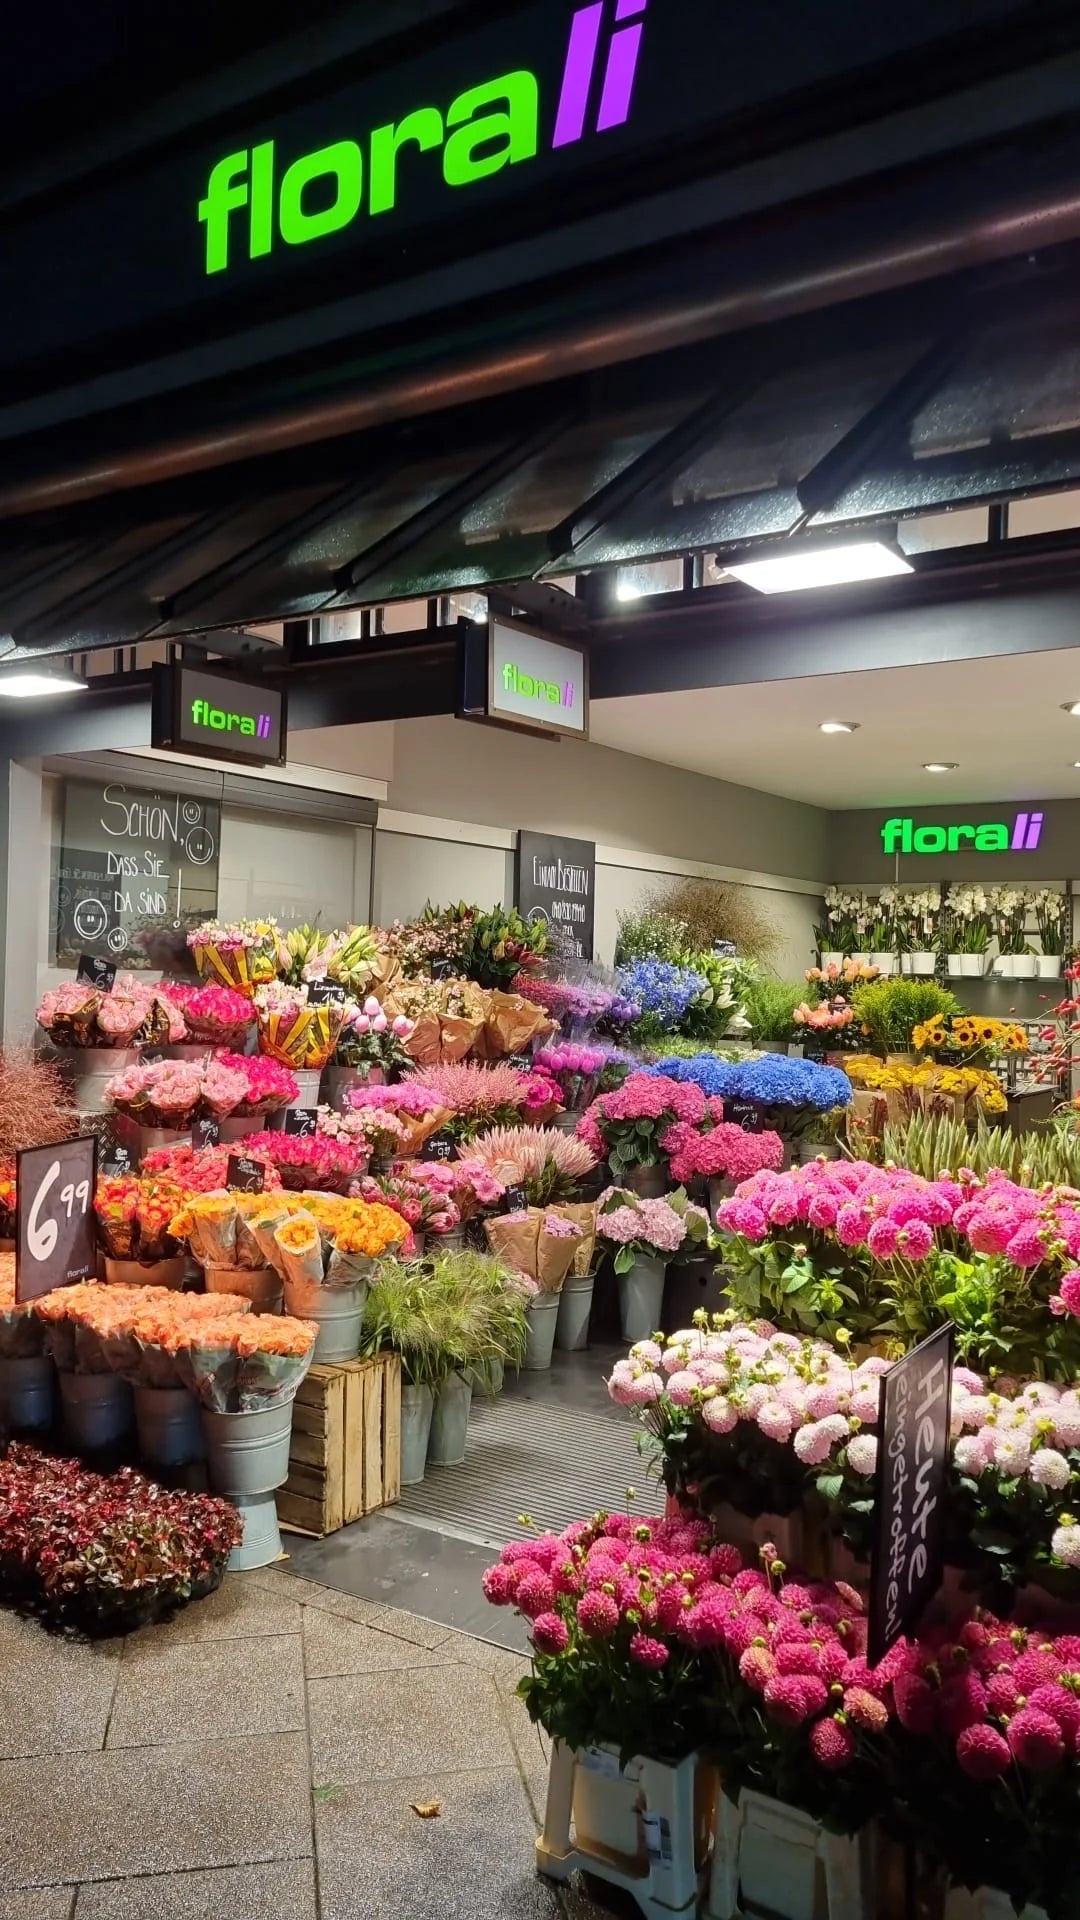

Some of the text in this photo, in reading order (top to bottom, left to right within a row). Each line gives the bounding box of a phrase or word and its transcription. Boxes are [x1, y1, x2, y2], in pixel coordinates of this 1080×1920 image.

[197, 0, 647, 275] florali
[502, 662, 573, 707] florali
[191, 699, 270, 738] florali
[881, 812, 1043, 854] florali
[907, 1358, 944, 1594] Heute
